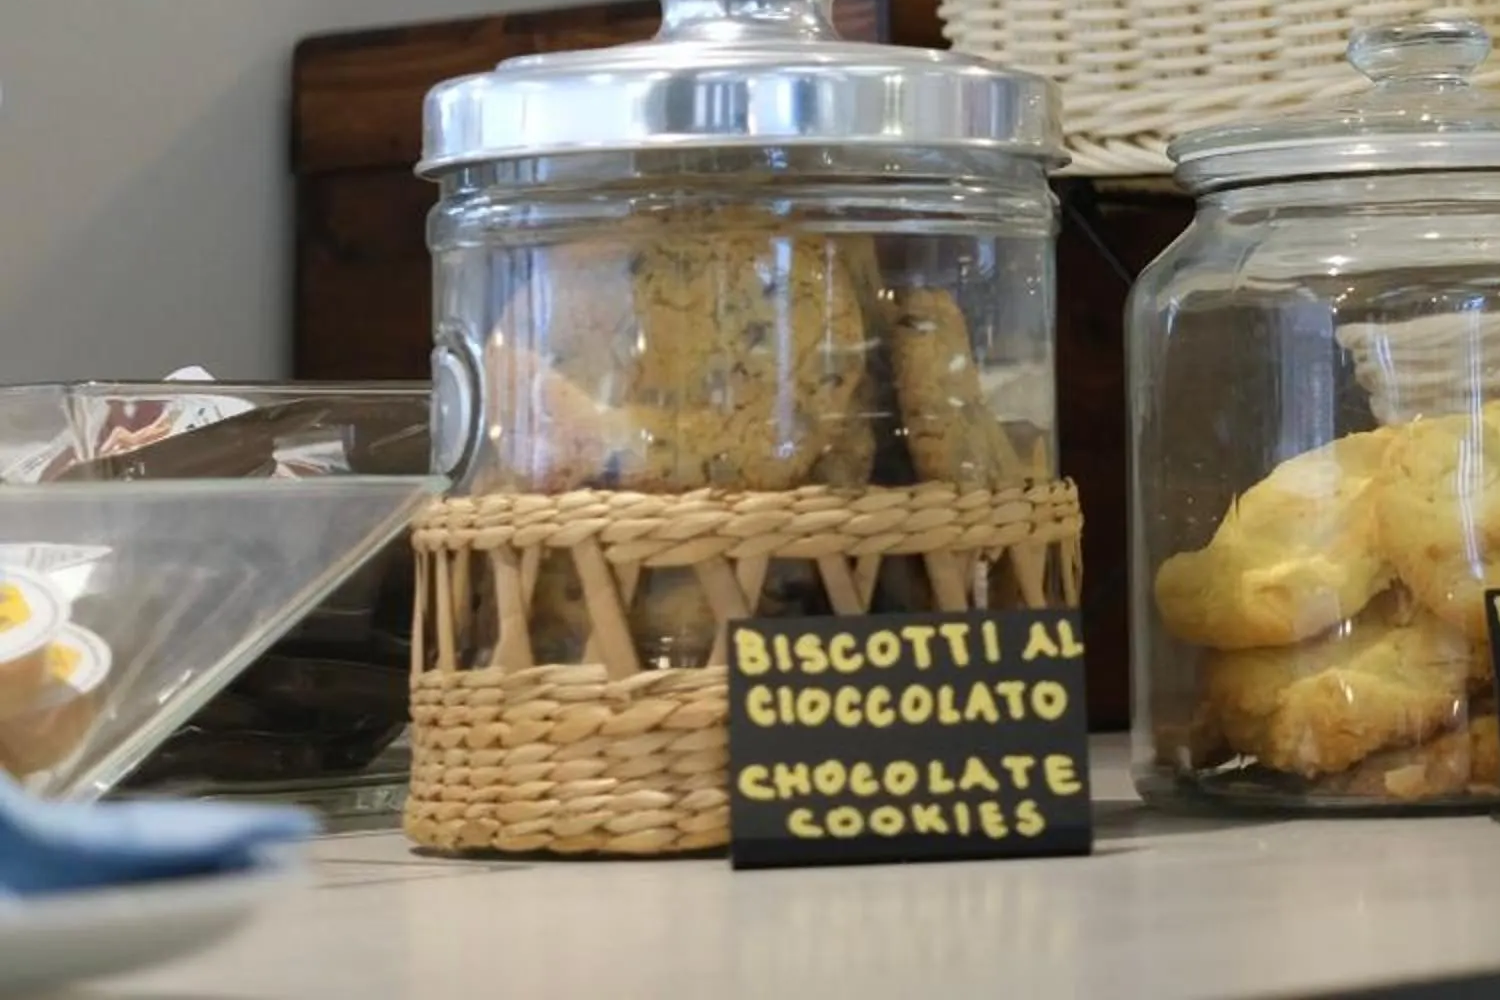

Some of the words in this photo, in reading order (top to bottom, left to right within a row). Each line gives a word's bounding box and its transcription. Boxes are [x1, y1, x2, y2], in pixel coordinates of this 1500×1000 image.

[734, 619, 1001, 675] BISCOTTI
[1022, 618, 1084, 660] AL
[746, 680, 1068, 728] CIOCCOLATO
[737, 754, 1082, 799] CHOCOLATE
[786, 798, 1046, 838] COOKIES
